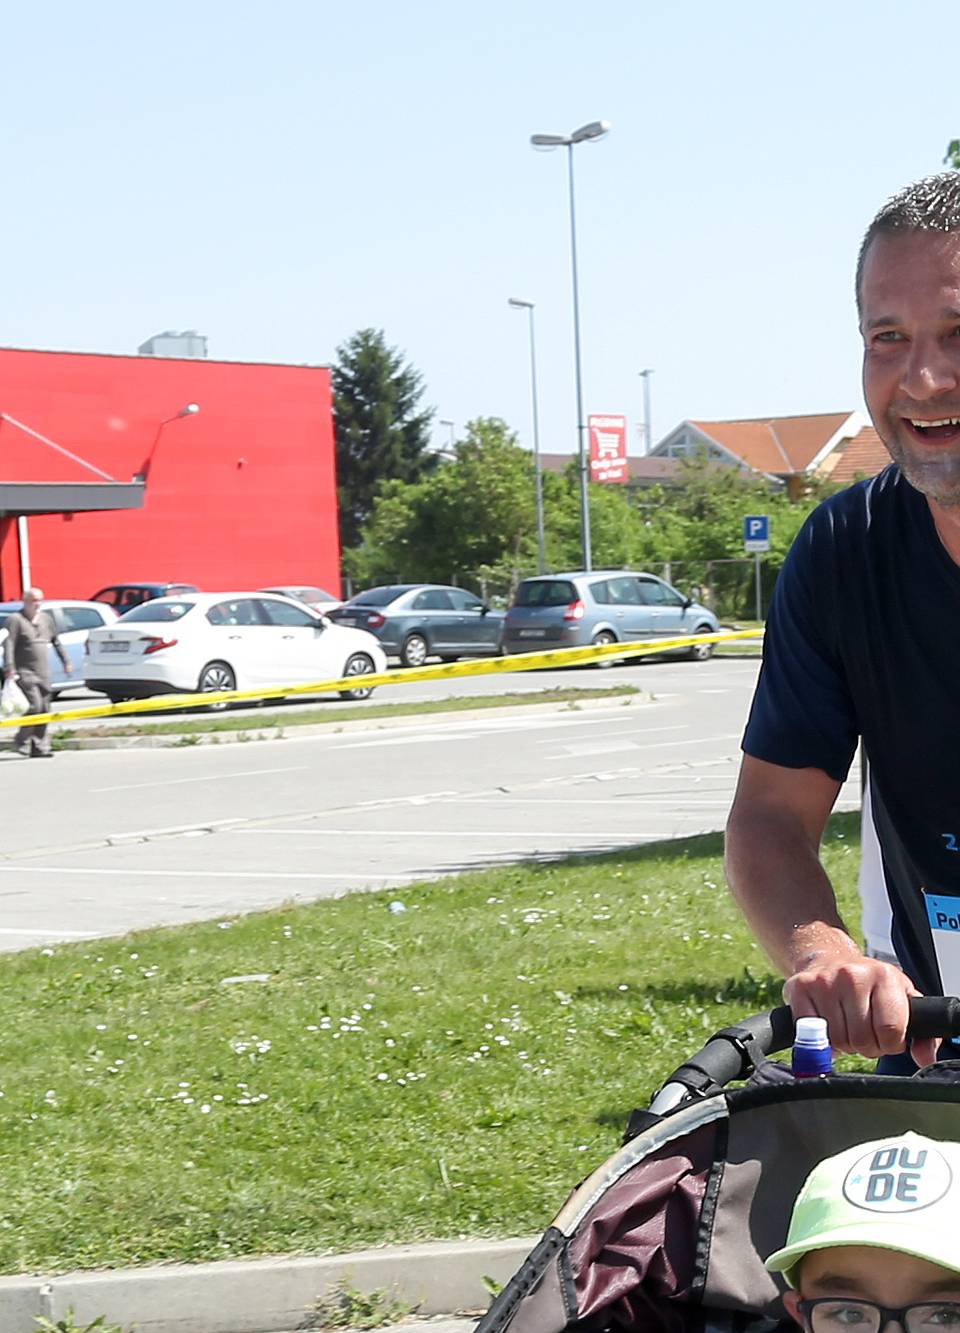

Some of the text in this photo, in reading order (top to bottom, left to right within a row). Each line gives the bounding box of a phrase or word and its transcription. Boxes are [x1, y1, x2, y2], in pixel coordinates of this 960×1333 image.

[750, 519, 763, 537] P
[869, 1146, 928, 1171] DU
[865, 1172, 921, 1202] DE
